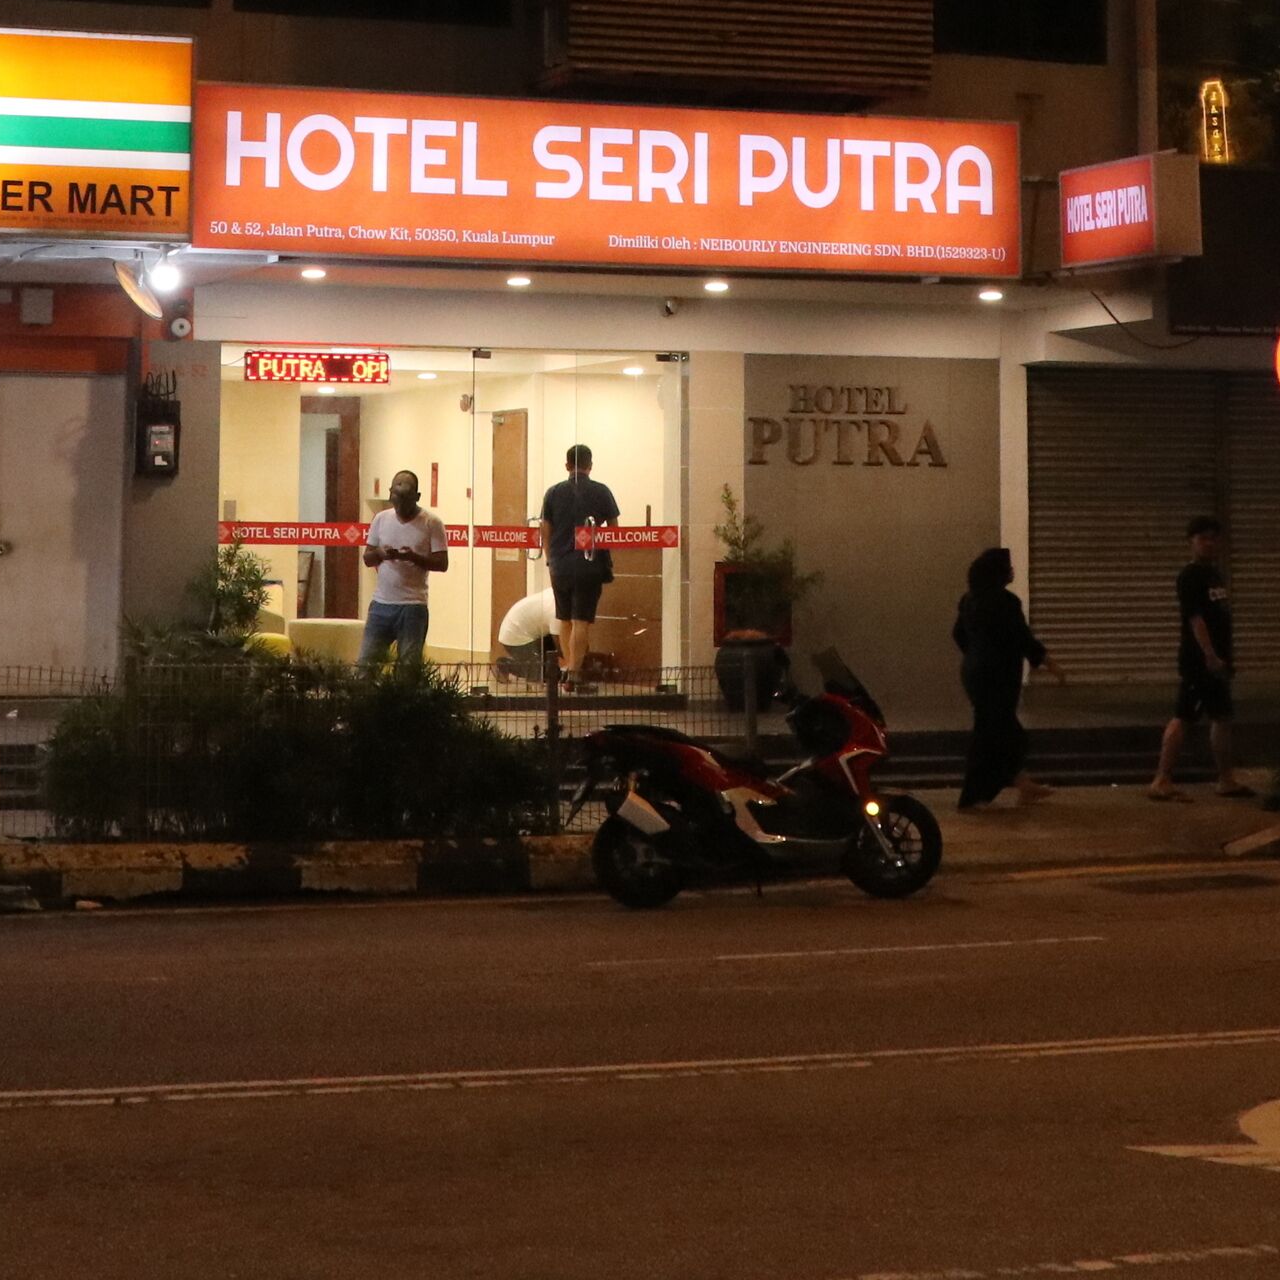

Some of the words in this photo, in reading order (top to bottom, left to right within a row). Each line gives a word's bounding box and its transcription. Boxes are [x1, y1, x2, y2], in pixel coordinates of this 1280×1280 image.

[225, 110, 508, 197] HOTEL
[532, 125, 709, 205] SERI
[739, 134, 994, 216] PUTRA
[68, 182, 180, 217] MART
[1067, 193, 1096, 233] HOTEL
[1095, 189, 1117, 229] SERI
[1117, 184, 1148, 226] PUTRA
[210, 221, 228, 234] 50
[231, 222, 243, 234] &
[245, 222, 265, 237] 52,
[267, 223, 303, 237] Jalan
[306, 224, 345, 240] Putra,
[348, 225, 387, 240] Chow
[389, 226, 412, 242] Kit,
[414, 228, 459, 243] 50350,
[462, 228, 499, 243] Kuala
[502, 230, 556, 248] Lumpur
[608, 234, 659, 249] Dimiliki
[661, 236, 691, 250] Oleh
[699, 238, 778, 253] NEIBOURLY
[779, 240, 872, 257] ENGINEERING
[874, 244, 904, 257] SDN.
[259, 358, 326, 377] PUTRA
[787, 384, 907, 415] HOTEL
[747, 417, 948, 468] PUTRA
[232, 526, 271, 539] HOTEL
[273, 527, 300, 539] SERI
[301, 527, 341, 539] PUTRA
[481, 531, 528, 543] WELLCOME
[594, 531, 659, 543] WELLCOME
